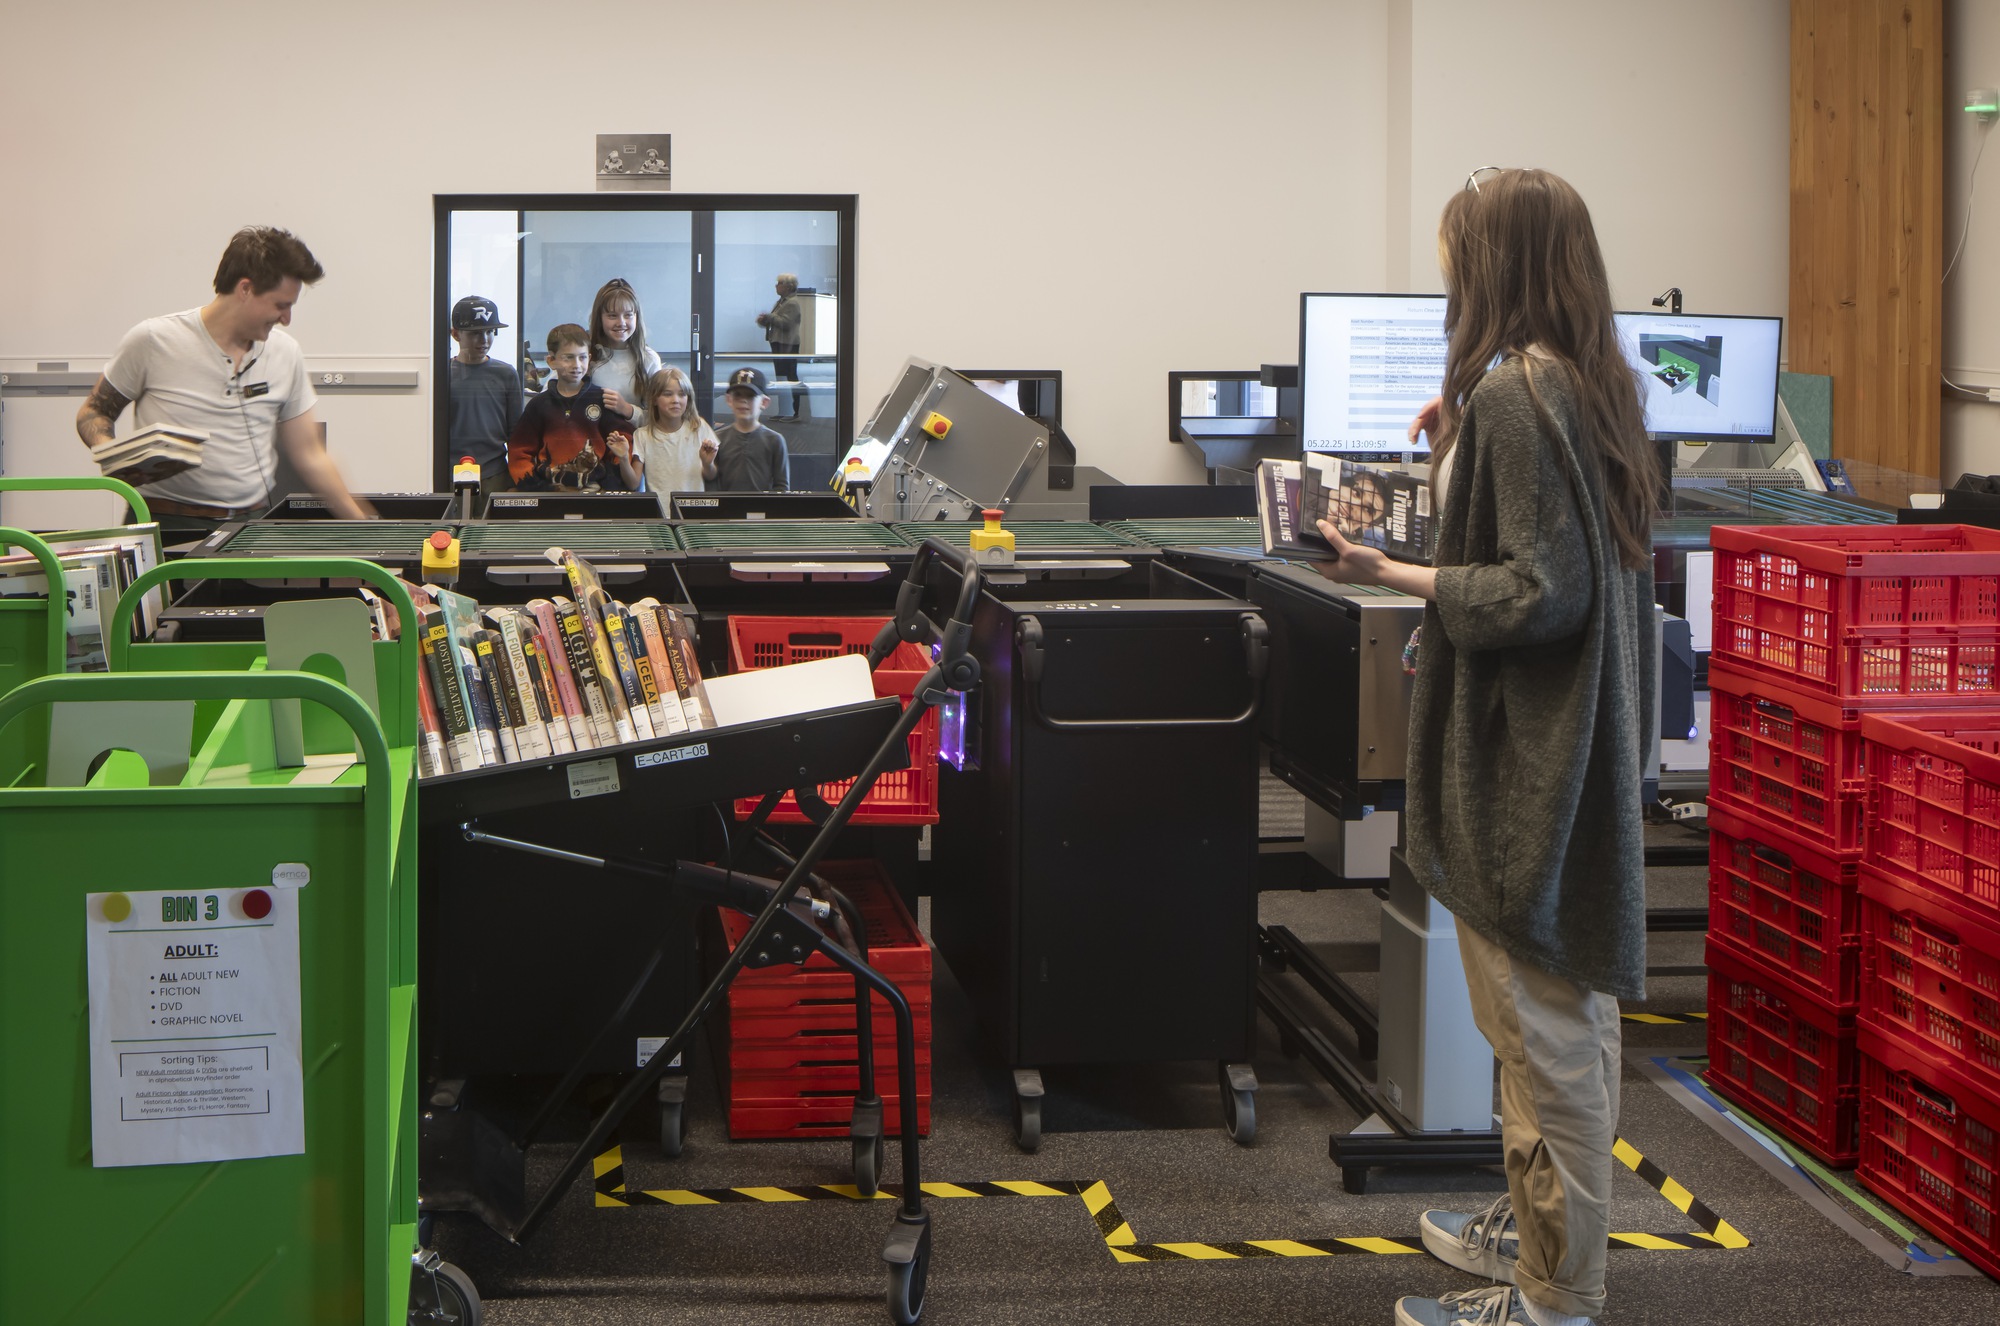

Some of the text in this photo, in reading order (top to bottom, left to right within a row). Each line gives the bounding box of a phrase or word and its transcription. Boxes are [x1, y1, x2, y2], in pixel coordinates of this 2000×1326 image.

[1307, 440, 1342, 448] 05.22.25
[1273, 465, 1293, 542] SUZANNE COLLINS
[1393, 489, 1410, 542] Truman
[434, 627, 445, 635] OCT
[502, 618, 516, 635] ALL
[567, 620, 579, 628] OCT
[641, 612, 652, 639] PIERCE
[647, 611, 659, 637] TAMORA
[478, 644, 489, 652] OCT
[555, 613, 576, 670] GIRL ON FILM
[507, 637, 524, 669] FOURS
[614, 641, 629, 673] BOX
[670, 648, 688, 691] ALANNA
[437, 638, 454, 674] MOSTLY
[446, 676, 466, 727] MEATLESS
[519, 681, 539, 723] MIRAND
[637, 745, 707, 767] E-CART-08
[162, 895, 219, 922] BIN 3
[164, 944, 219, 958] ADULT:
[160, 969, 240, 982] ALL ADULT NEW
[160, 986, 200, 996] FICTION
[160, 1002, 183, 1011] DVD
[160, 1013, 243, 1026] GRAPHIC NOVEL
[161, 1055, 218, 1065] Sorting Tips:
